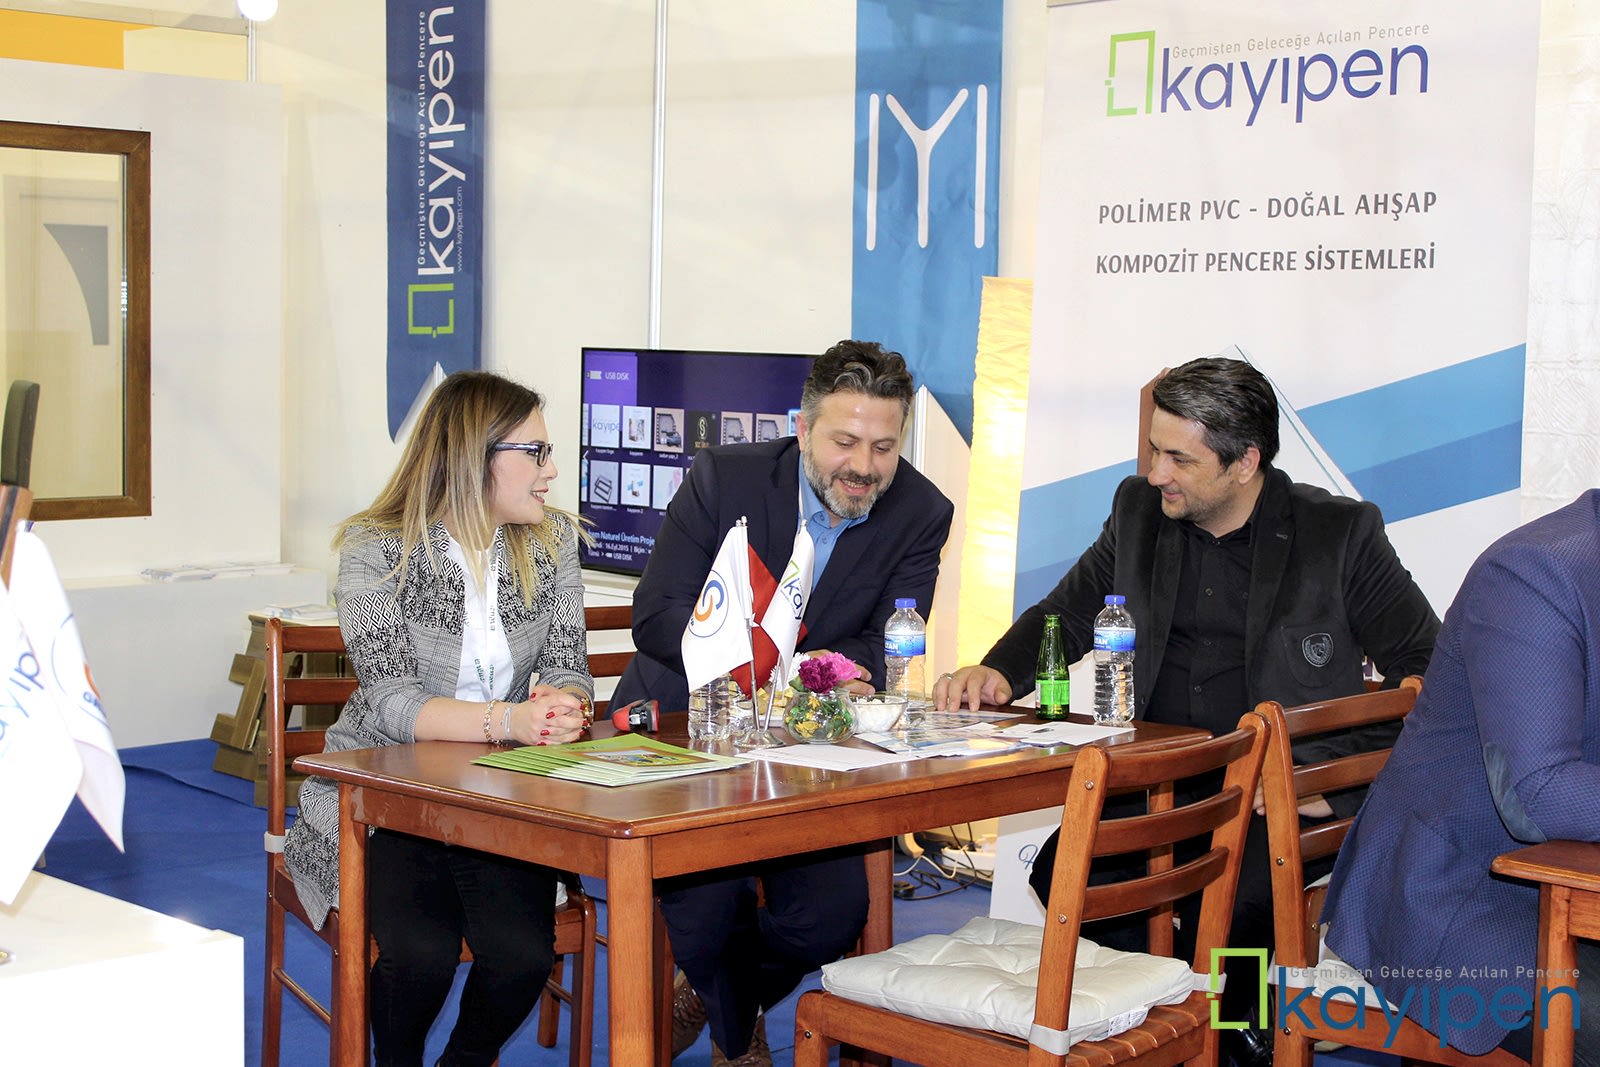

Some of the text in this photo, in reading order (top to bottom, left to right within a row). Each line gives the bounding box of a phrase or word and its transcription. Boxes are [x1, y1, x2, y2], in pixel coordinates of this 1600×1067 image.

[417, 11, 426, 68] Pencere
[1172, 24, 1430, 59] Geçmişten Geleceğe Açılan Pencere
[1160, 44, 1428, 126] kayıpen
[417, 6, 466, 276] kayıpen
[1099, 198, 1191, 224] POLİMER
[1200, 199, 1240, 220] PVC
[1267, 191, 1345, 218] DOĞAL
[1355, 191, 1437, 221] AHŞAP
[1096, 241, 1435, 274] KOMPOZİT PENCERE SİSTEMLERİ
